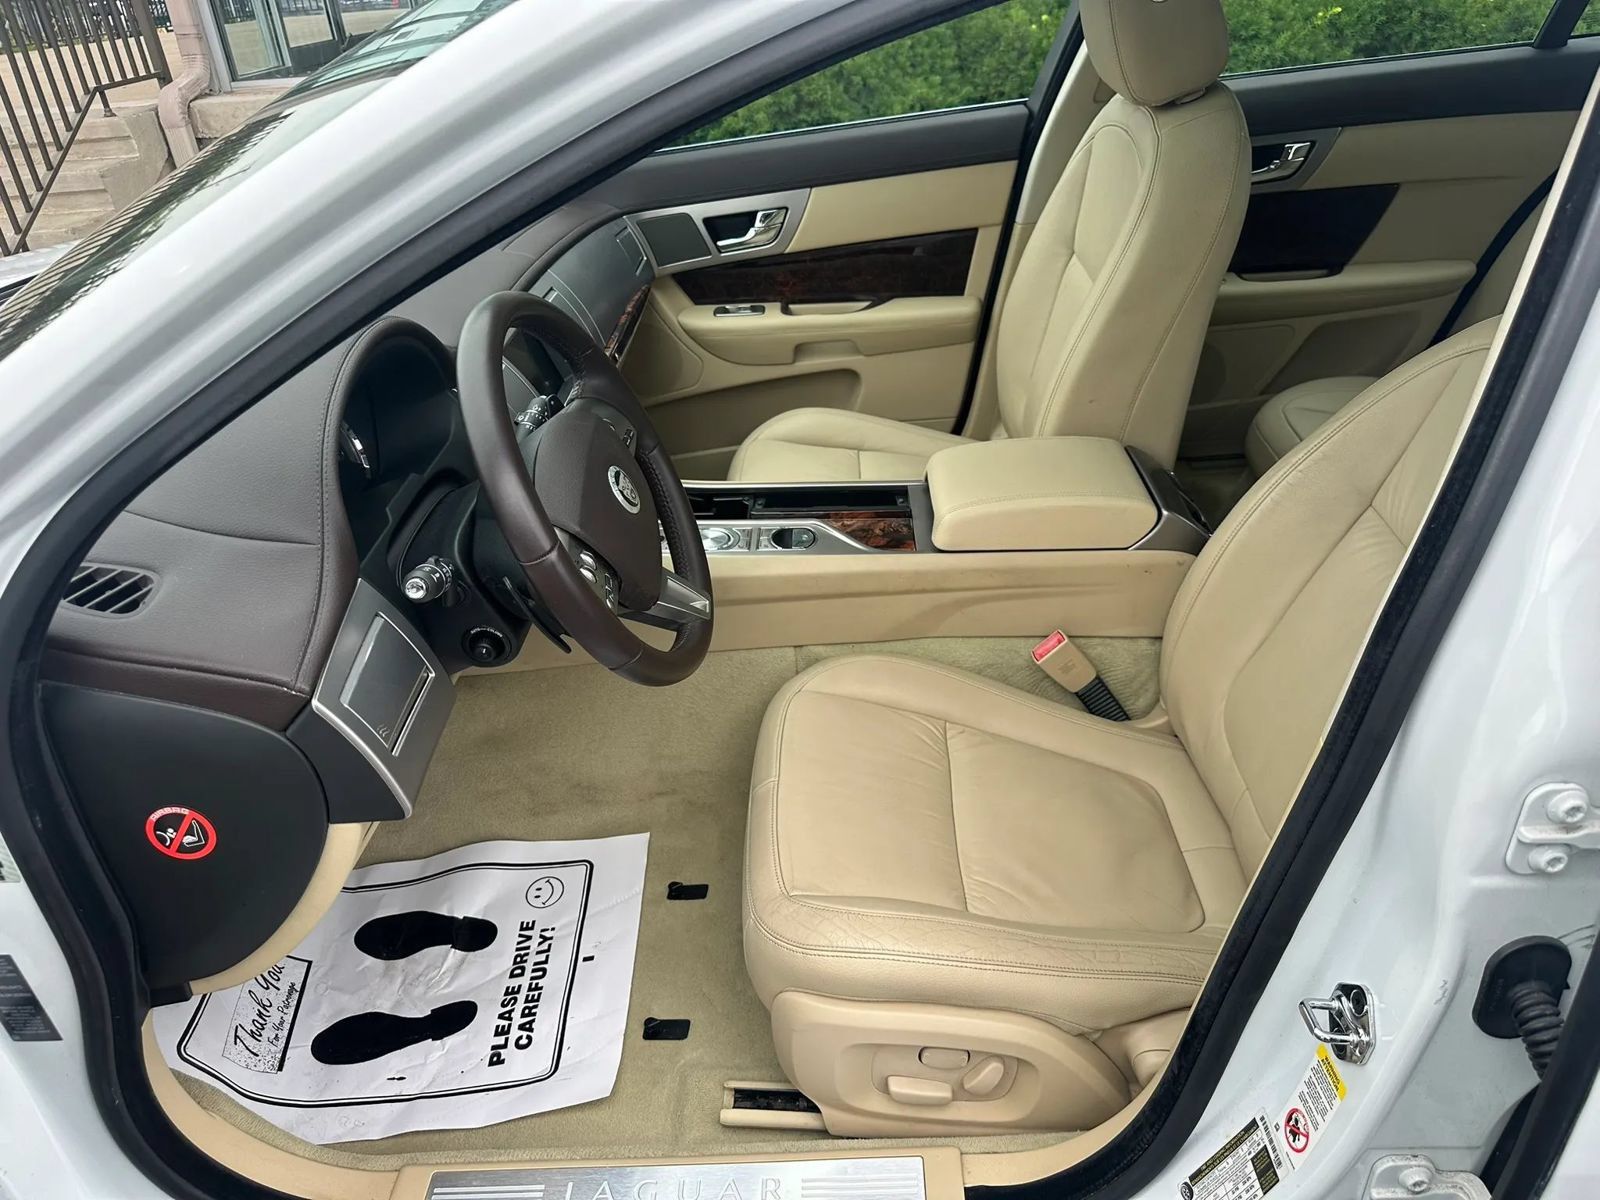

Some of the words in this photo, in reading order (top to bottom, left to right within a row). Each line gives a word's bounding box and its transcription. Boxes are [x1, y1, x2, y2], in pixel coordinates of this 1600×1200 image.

[149, 807, 190, 822] AIRBAG
[233, 989, 273, 1058] Thank
[254, 964, 285, 992] You
[488, 984, 523, 1067] PLEASE
[508, 919, 537, 980] DRIVE
[514, 926, 556, 1051] CAREFULLY!
[267, 1033, 280, 1048] For
